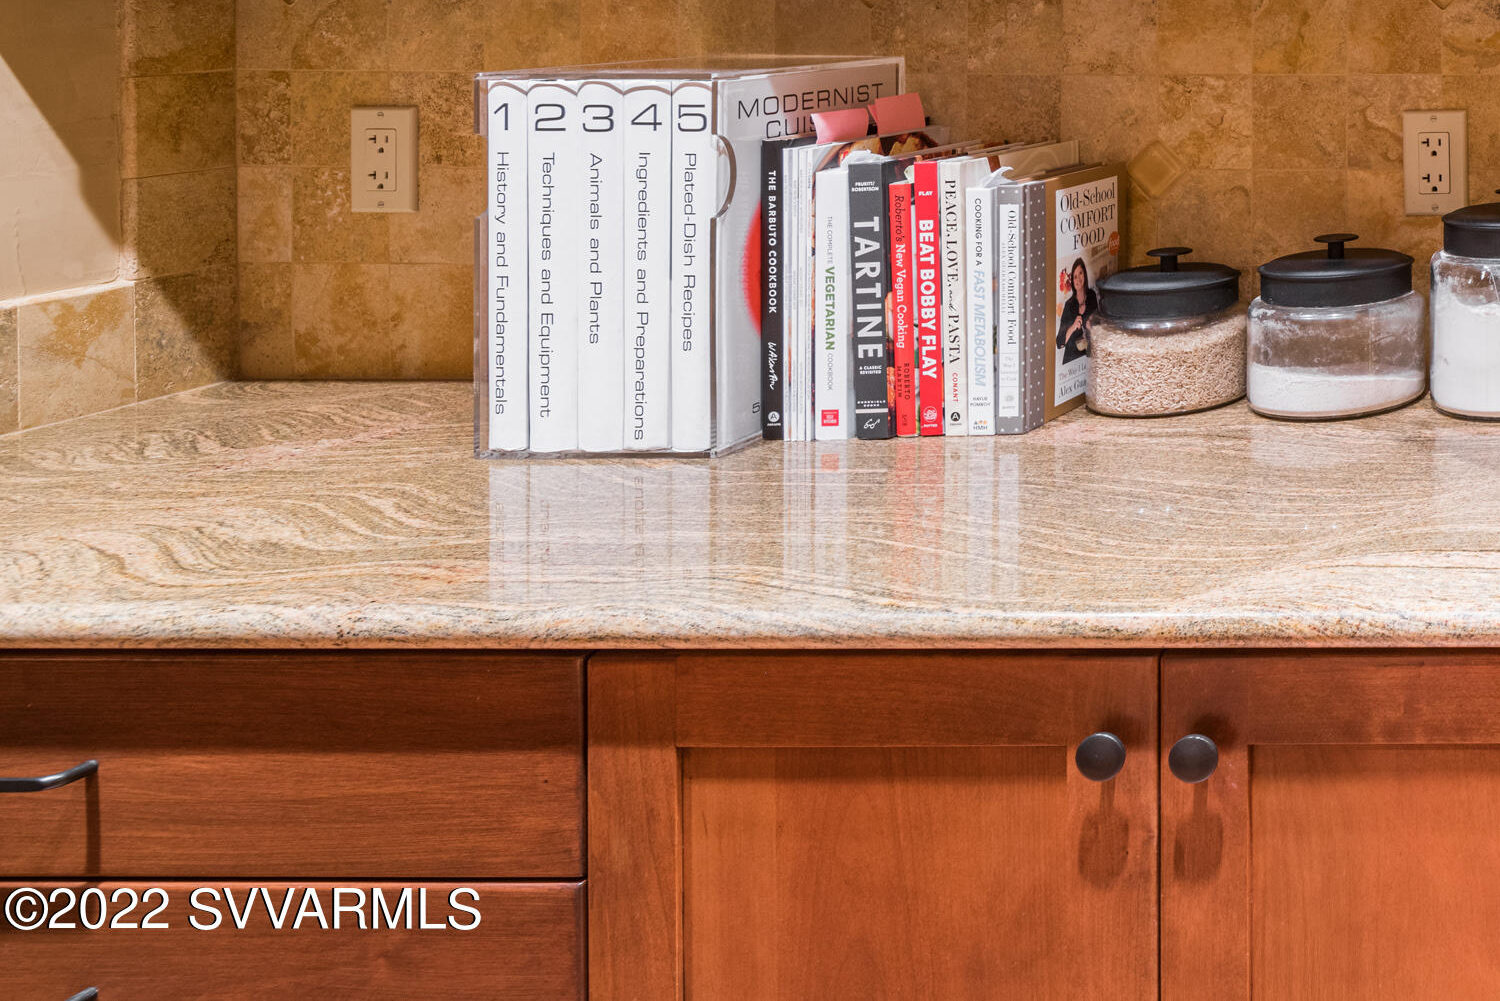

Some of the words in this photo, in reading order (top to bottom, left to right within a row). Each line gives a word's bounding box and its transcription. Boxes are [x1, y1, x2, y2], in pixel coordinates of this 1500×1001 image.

[494, 102, 509, 131] 1
[534, 103, 567, 132] 2
[582, 104, 614, 133] 3
[630, 103, 663, 132] 4
[677, 104, 708, 133] 5
[738, 83, 884, 120] MODERNIST
[494, 151, 510, 225] History
[590, 153, 603, 230] Animals
[768, 170, 777, 191] THE
[1060, 182, 1115, 212] Old-School
[540, 152, 555, 261] Techniques
[636, 152, 651, 261] Ingredients
[684, 153, 697, 266] Plated-Dish
[768, 196, 777, 246] BARBUTO
[895, 195, 906, 242] Roberto's
[974, 198, 982, 239] COOKING
[1060, 204, 1115, 234] COMFORT
[496, 231, 509, 267] and
[589, 238, 602, 273] and
[895, 244, 906, 267] New
[919, 219, 935, 265] BEAT
[1007, 210, 1017, 268] Old-School
[1073, 227, 1105, 250] FOOD
[540, 269, 553, 304] and
[636, 269, 649, 304] and
[768, 250, 777, 313] COOKBOOK
[853, 216, 883, 359] TARTINE
[894, 269, 907, 302] Vegan
[920, 269, 936, 331] BOBBY
[974, 270, 985, 300] FAST
[1007, 271, 1017, 314] Comfort
[589, 282, 603, 344] Plants
[681, 274, 696, 352] Recipes
[825, 266, 835, 350] VEGETARIAN
[896, 305, 908, 349] Cooking
[495, 275, 509, 415] Fundamentals
[948, 315, 960, 364] PASTA
[974, 303, 986, 387] METABOLISM
[1007, 319, 1017, 345] Food
[538, 313, 554, 418] Equipment
[634, 312, 649, 440] Preparations
[921, 335, 938, 380] FLAY
